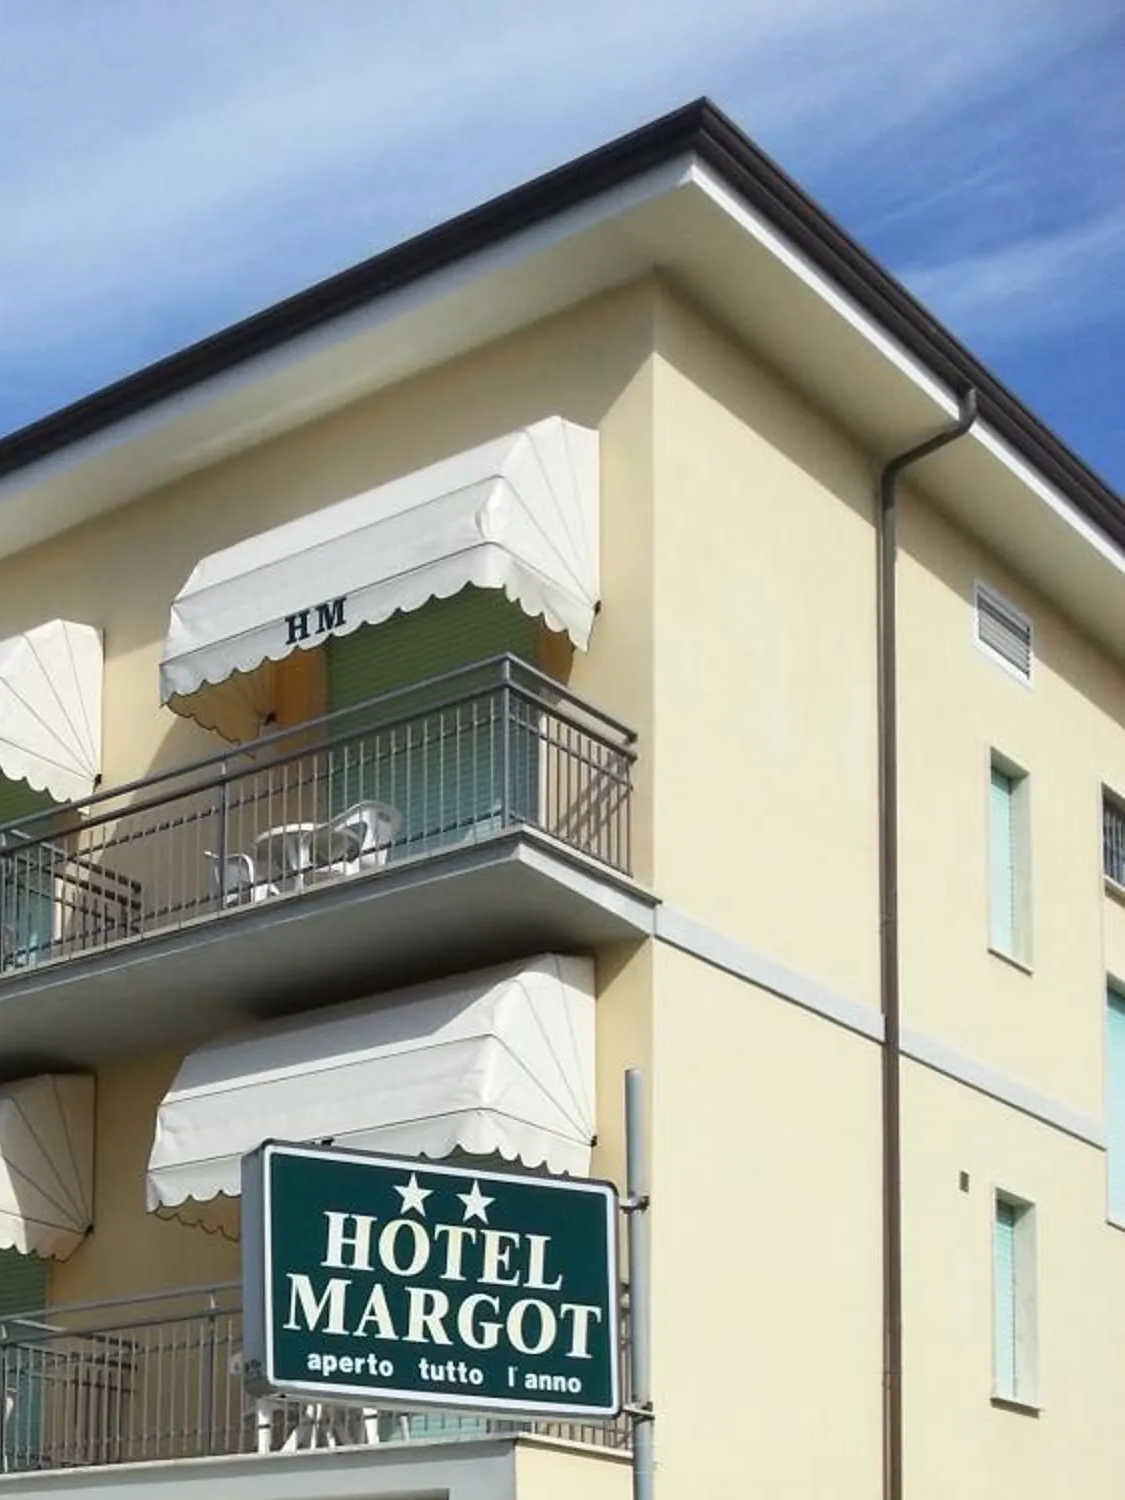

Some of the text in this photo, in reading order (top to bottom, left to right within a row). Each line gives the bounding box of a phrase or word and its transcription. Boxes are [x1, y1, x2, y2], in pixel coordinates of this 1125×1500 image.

[320, 1210, 563, 1291] HOTEL
[282, 1272, 602, 1360] MARGOT
[306, 1351, 395, 1378] aperto
[418, 1358, 484, 1386] tutto
